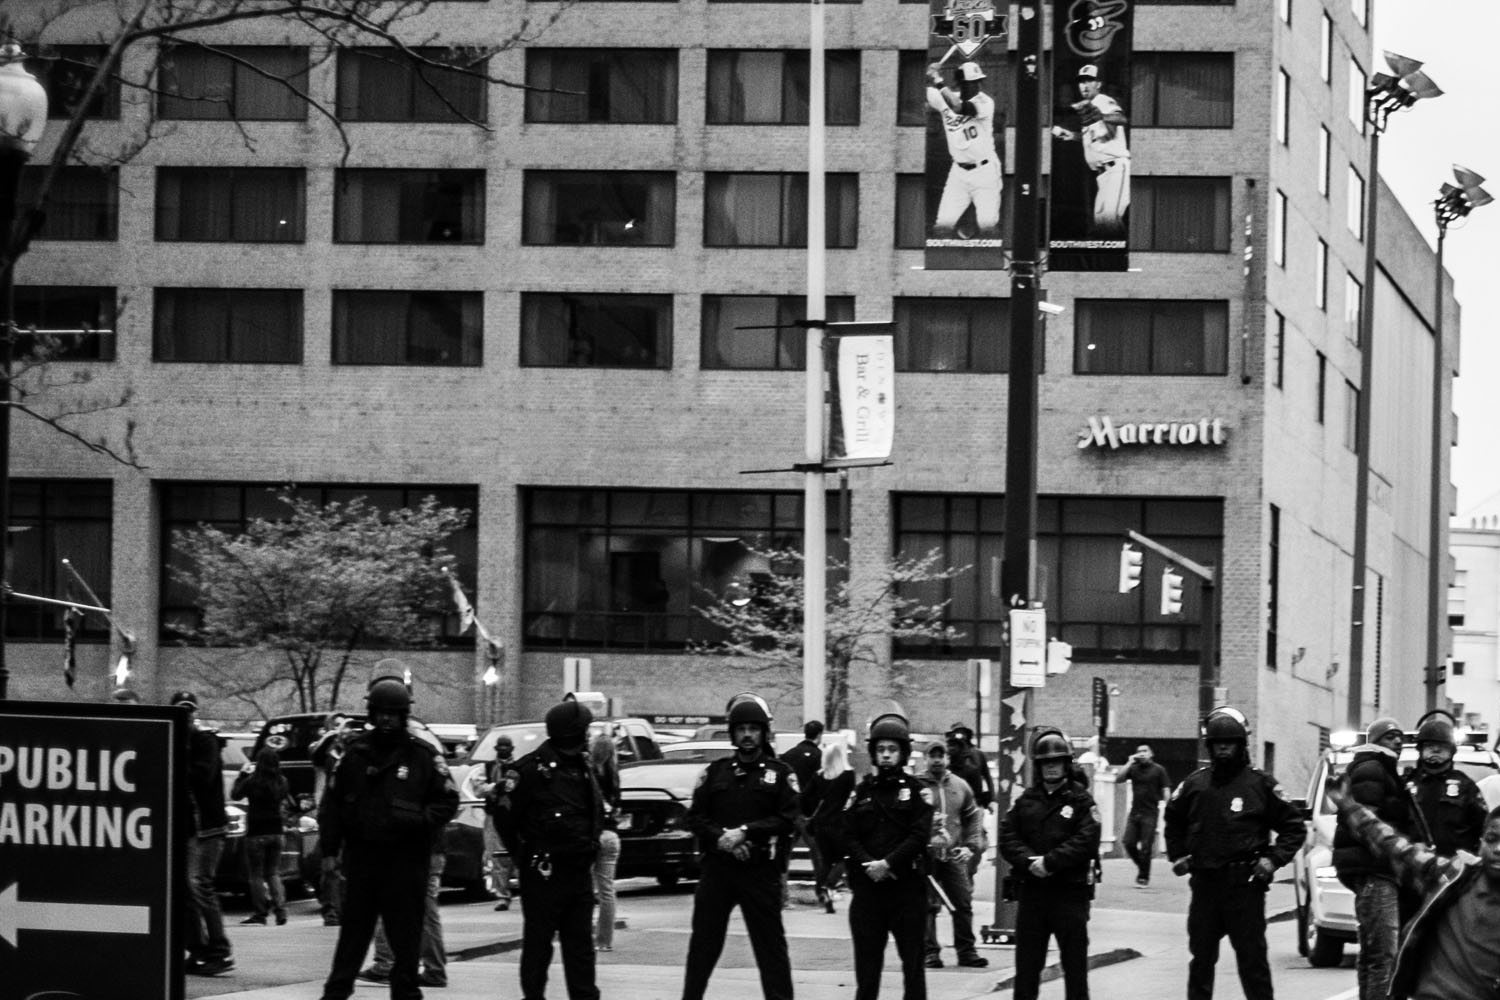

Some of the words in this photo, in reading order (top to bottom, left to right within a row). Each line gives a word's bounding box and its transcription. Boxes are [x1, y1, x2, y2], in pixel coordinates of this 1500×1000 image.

[952, 14, 986, 43] 60
[962, 125, 978, 142] 10
[925, 238, 1003, 248] SOUTHWEST.COM
[1050, 240, 1126, 249] SOUTHWEST.COM
[856, 354, 869, 379] Bar
[856, 385, 871, 399] &
[856, 406, 871, 442] Grill
[1076, 415, 1227, 450] Marriott
[0, 746, 137, 793] PUBLIC
[0, 802, 152, 850] ARKING
